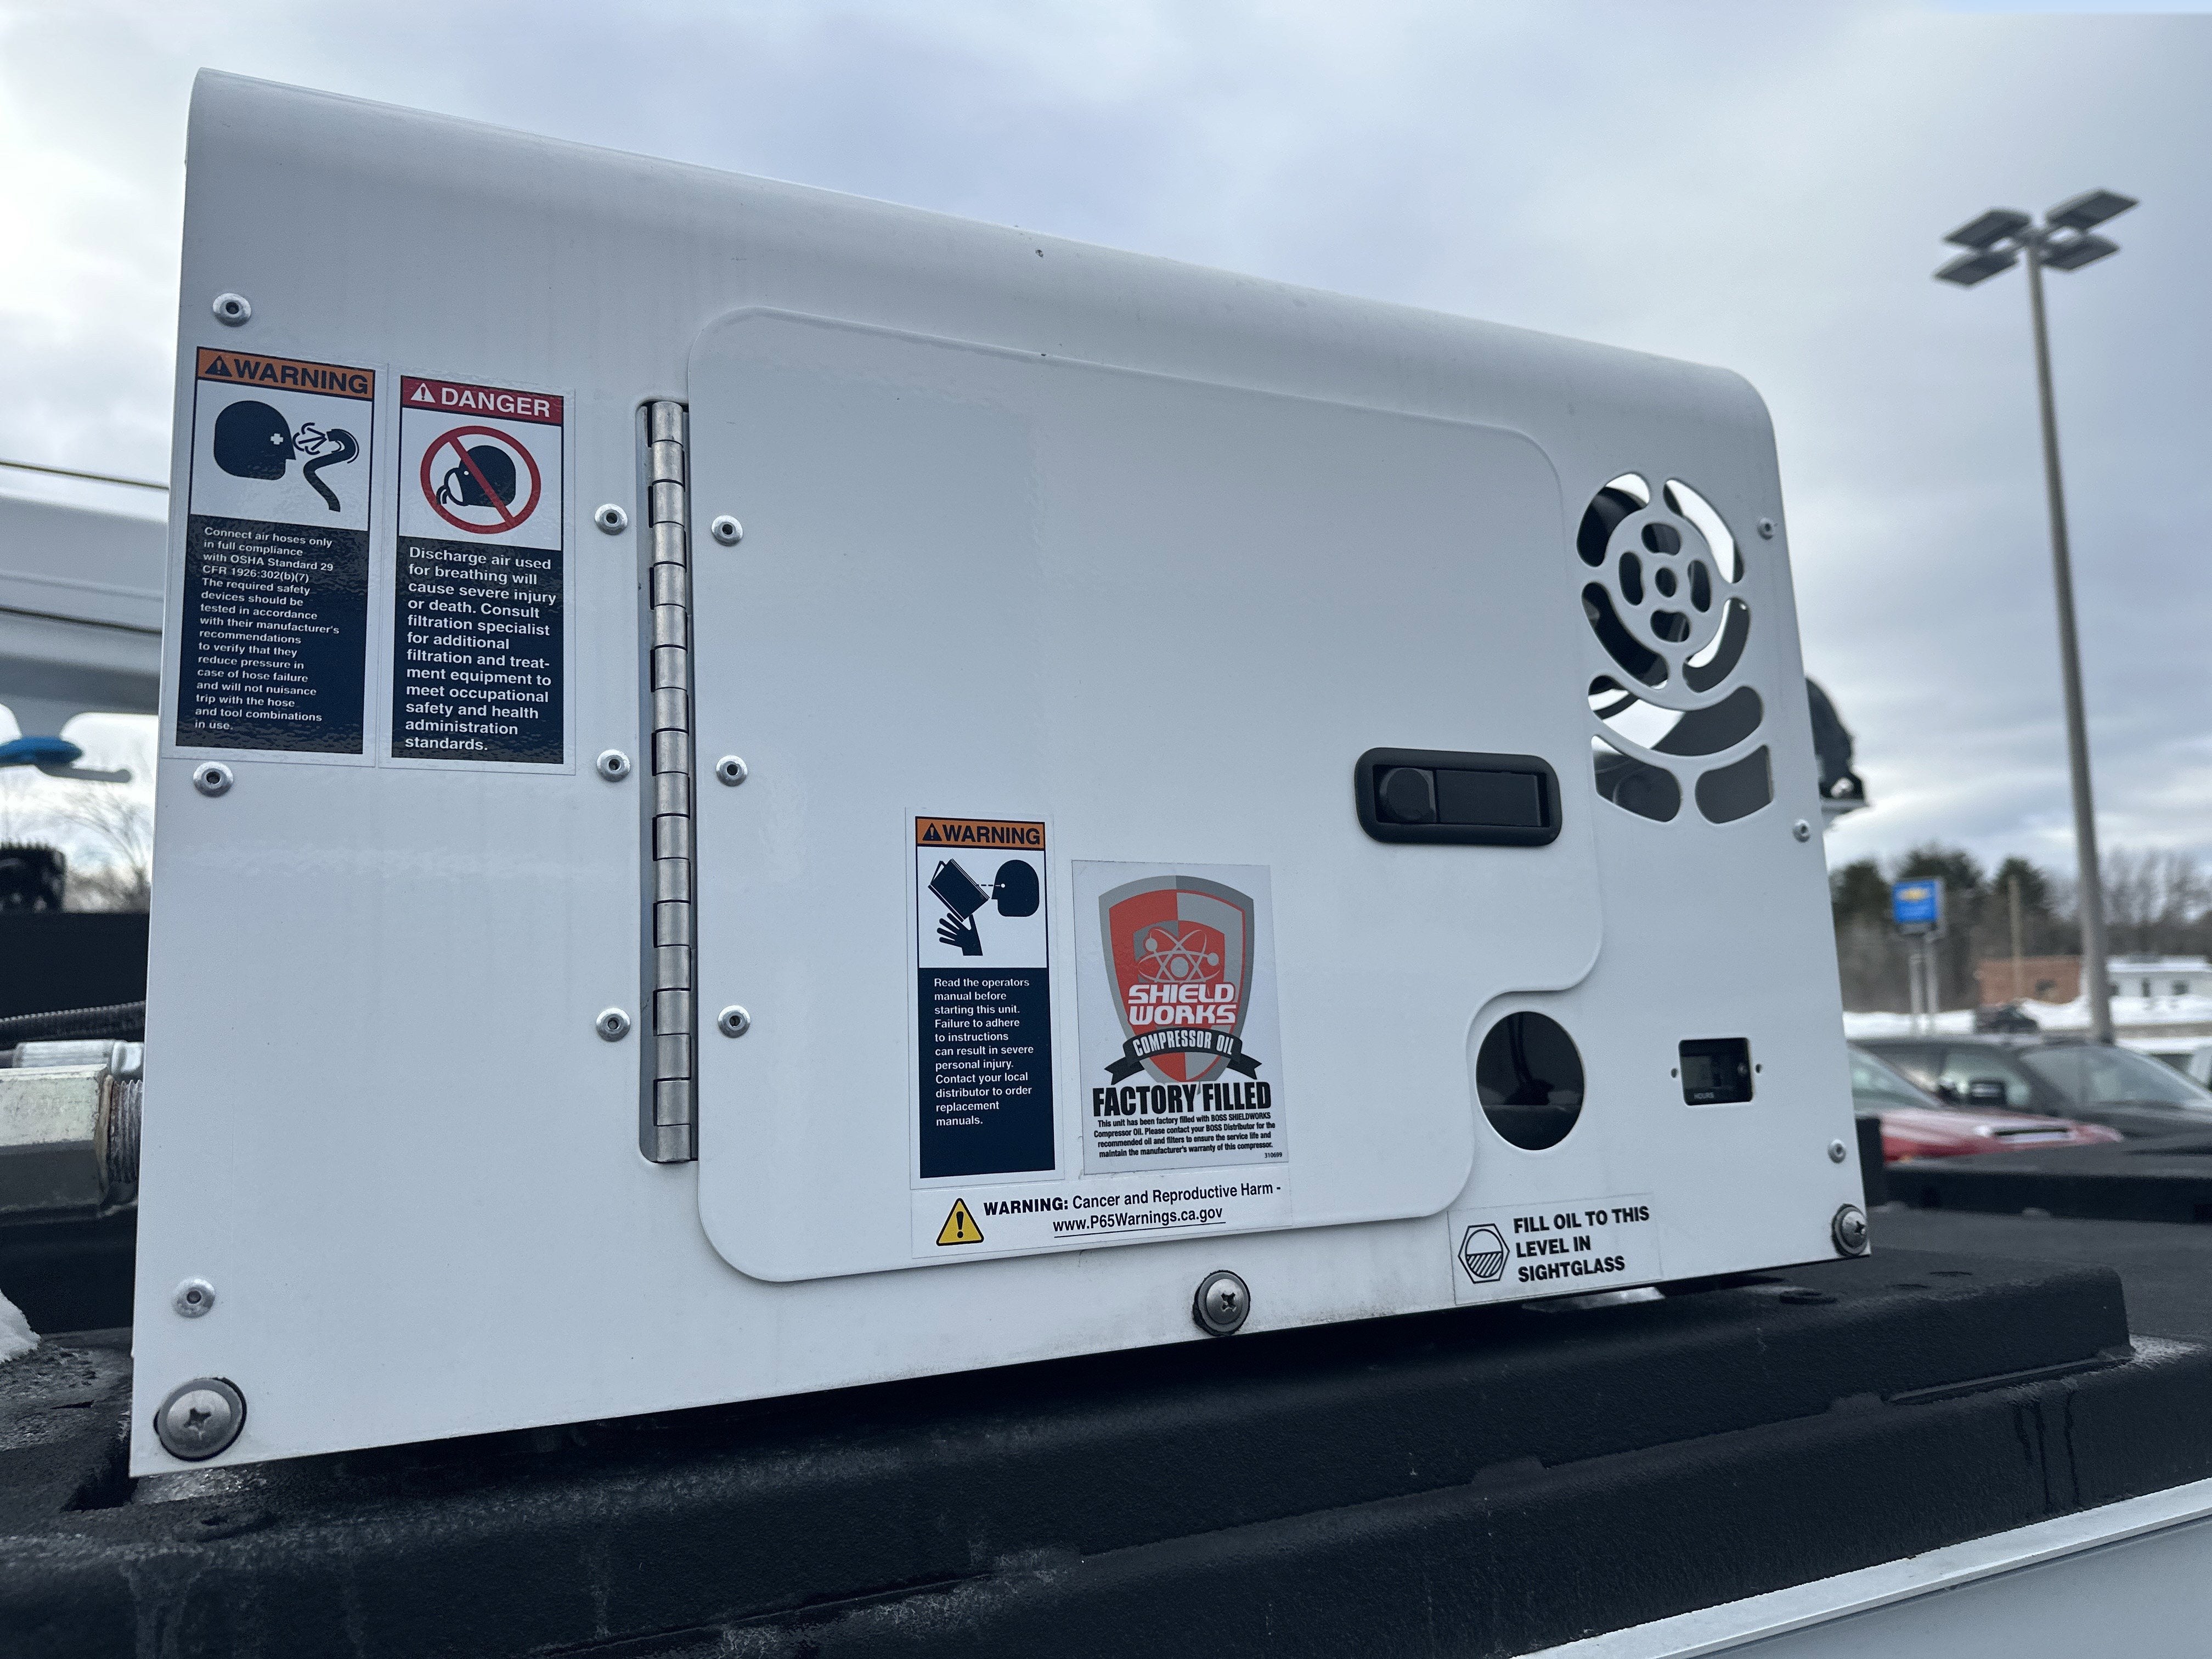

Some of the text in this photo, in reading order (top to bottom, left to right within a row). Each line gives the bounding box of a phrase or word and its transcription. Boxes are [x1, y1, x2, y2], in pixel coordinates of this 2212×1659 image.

[233, 358, 369, 395] WARNING
[441, 387, 551, 418] DANGER
[204, 526, 252, 539] Connect
[272, 533, 306, 544] hoses
[308, 538, 332, 548] only
[217, 540, 235, 550] full
[238, 544, 303, 556] compliance
[202, 553, 334, 572] with OSHA Standard 29
[409, 546, 551, 569] Discharge air used
[202, 564, 309, 584] CFR 1926:302(b)(7)
[408, 563, 537, 585] for breathing will
[201, 577, 311, 596] The required safety
[408, 582, 556, 606] cause severe injury
[201, 590, 303, 606] devices should be
[200, 603, 236, 613] tested
[252, 608, 318, 620] accordance
[407, 599, 540, 618] or death. Consult
[199, 617, 340, 634] with their manufacturer's
[407, 614, 550, 636] filtration specialist
[199, 630, 301, 644] recommendations
[407, 631, 509, 650] for additional
[198, 641, 297, 658] to verify that they
[198, 655, 238, 665] reduce
[240, 659, 291, 668] pressure
[406, 648, 550, 669] filtration and treat-
[197, 669, 308, 682] case of hose failure
[407, 668, 551, 686] ment equipment to
[196, 681, 317, 696] and will not nuisance
[406, 685, 548, 702] meet occupational
[195, 693, 295, 707] trip with the hose
[194, 707, 322, 721] and tool combinations
[405, 701, 538, 719] safety and health
[405, 718, 518, 735] administration
[404, 736, 488, 751] standards.
[942, 823, 1040, 845] WARNING
[934, 977, 1030, 989] Read the operators
[934, 991, 1007, 1001] manual before
[1128, 983, 1235, 1004] SHIELD
[934, 1004, 1020, 1016] starting this unit.
[1129, 1003, 1237, 1025] WORKS
[934, 1018, 1020, 1028] Failure to adhere
[934, 1031, 1009, 1042] to instructions
[1132, 1029, 1234, 1057] COMPRESSOR OIL
[934, 1045, 1034, 1056] can result in severe
[935, 1058, 1014, 1072] personal injury.
[935, 1071, 1028, 1085] Contact your local
[935, 1085, 1032, 1098] distributor to order
[1092, 1081, 1271, 1117] FACTORY FILLED
[935, 1100, 1000, 1114] replacement
[936, 1115, 983, 1126] manuals.
[1097, 1111, 1271, 1128] This unit has been factory filled with BOSS SHIELDWORKS
[1093, 1129, 1132, 1138] Compressor
[1132, 1127, 1144, 1136] Oil.
[1144, 1127, 1165, 1135] Please
[1166, 1125, 1190, 1134] contact
[1190, 1125, 1205, 1134] your
[1205, 1123, 1222, 1132] BOSS
[1223, 1122, 1255, 1131] Distributor
[983, 1196, 1068, 1216] WARNING:
[1072, 1194, 1120, 1209] Cancer
[1124, 1189, 1148, 1205] and
[1152, 1184, 1237, 1205] Reproductive
[1240, 1182, 1273, 1196] Harm
[1052, 1207, 1222, 1232] www.P65Warnings.ca.gov
[1513, 1205, 1650, 1234] FILL OIL TO THIS
[1515, 1234, 1591, 1258] LEVEL IN
[1517, 1255, 1625, 1283] SIGHTGLASS
